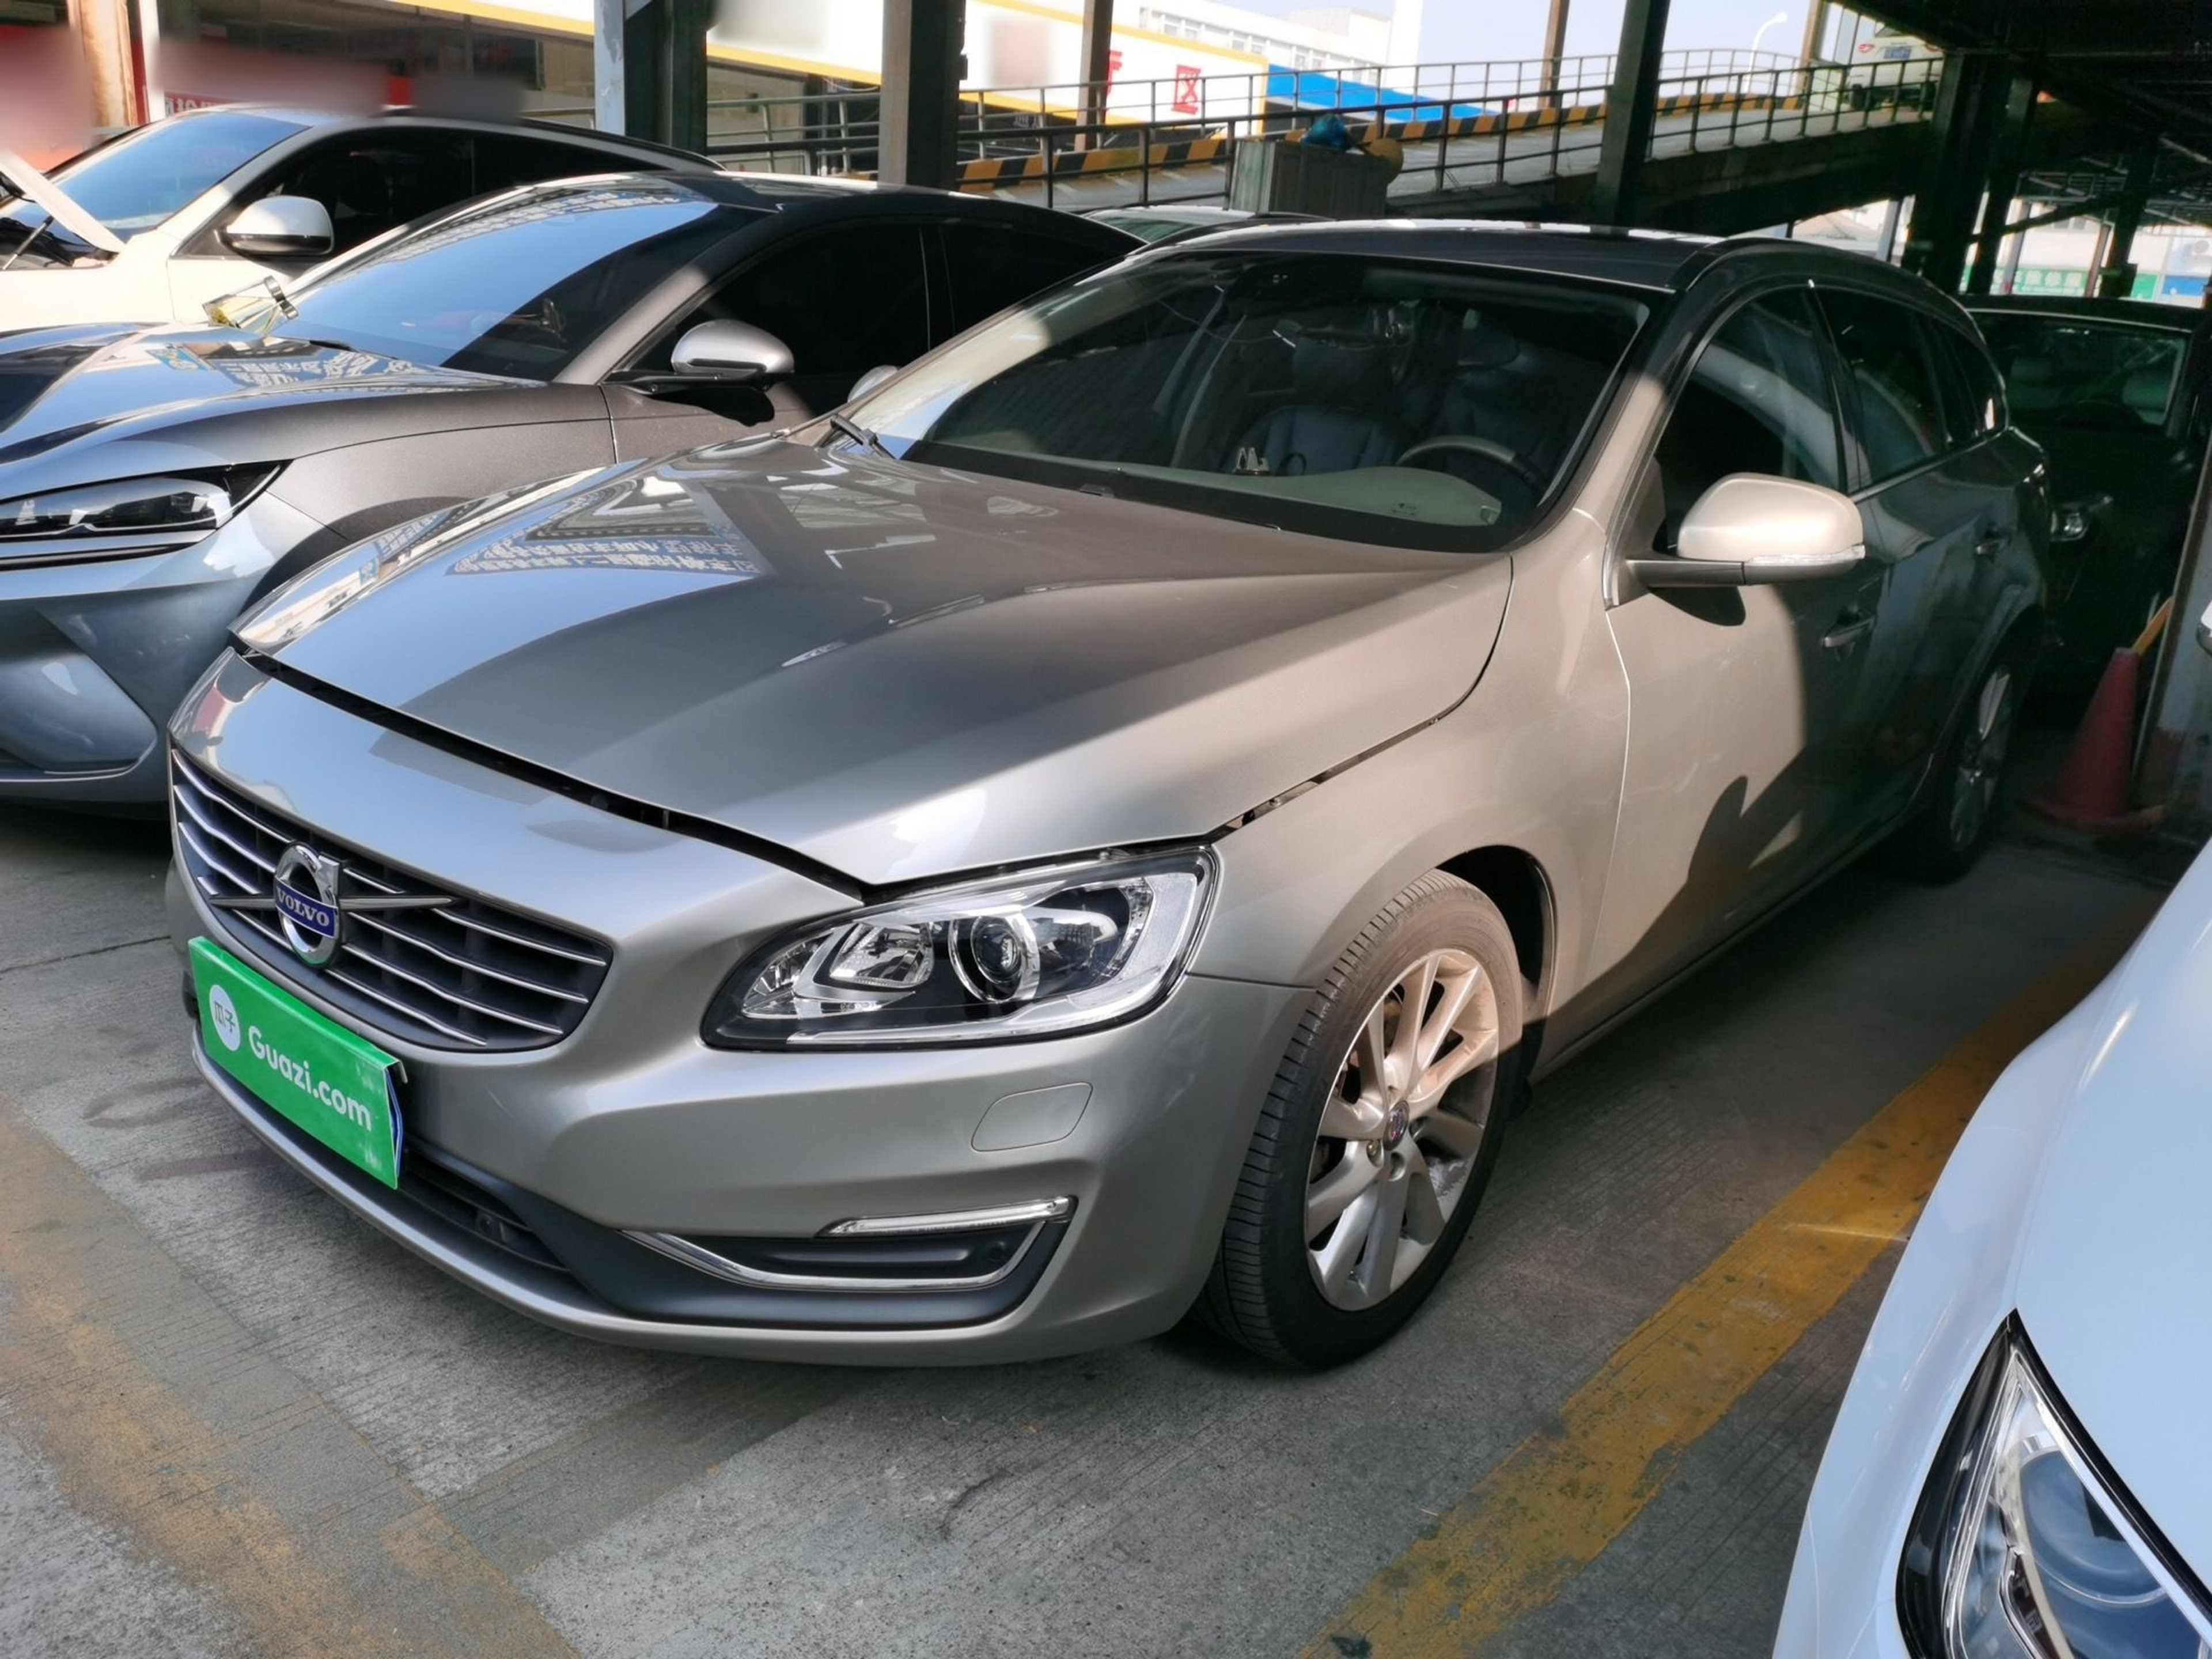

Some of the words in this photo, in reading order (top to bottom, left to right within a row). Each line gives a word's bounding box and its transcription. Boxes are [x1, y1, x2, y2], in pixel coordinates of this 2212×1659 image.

[276, 887, 329, 927] VOLVO
[214, 1000, 236, 1033] 瓜子
[248, 1025, 372, 1132] Guazi.com
